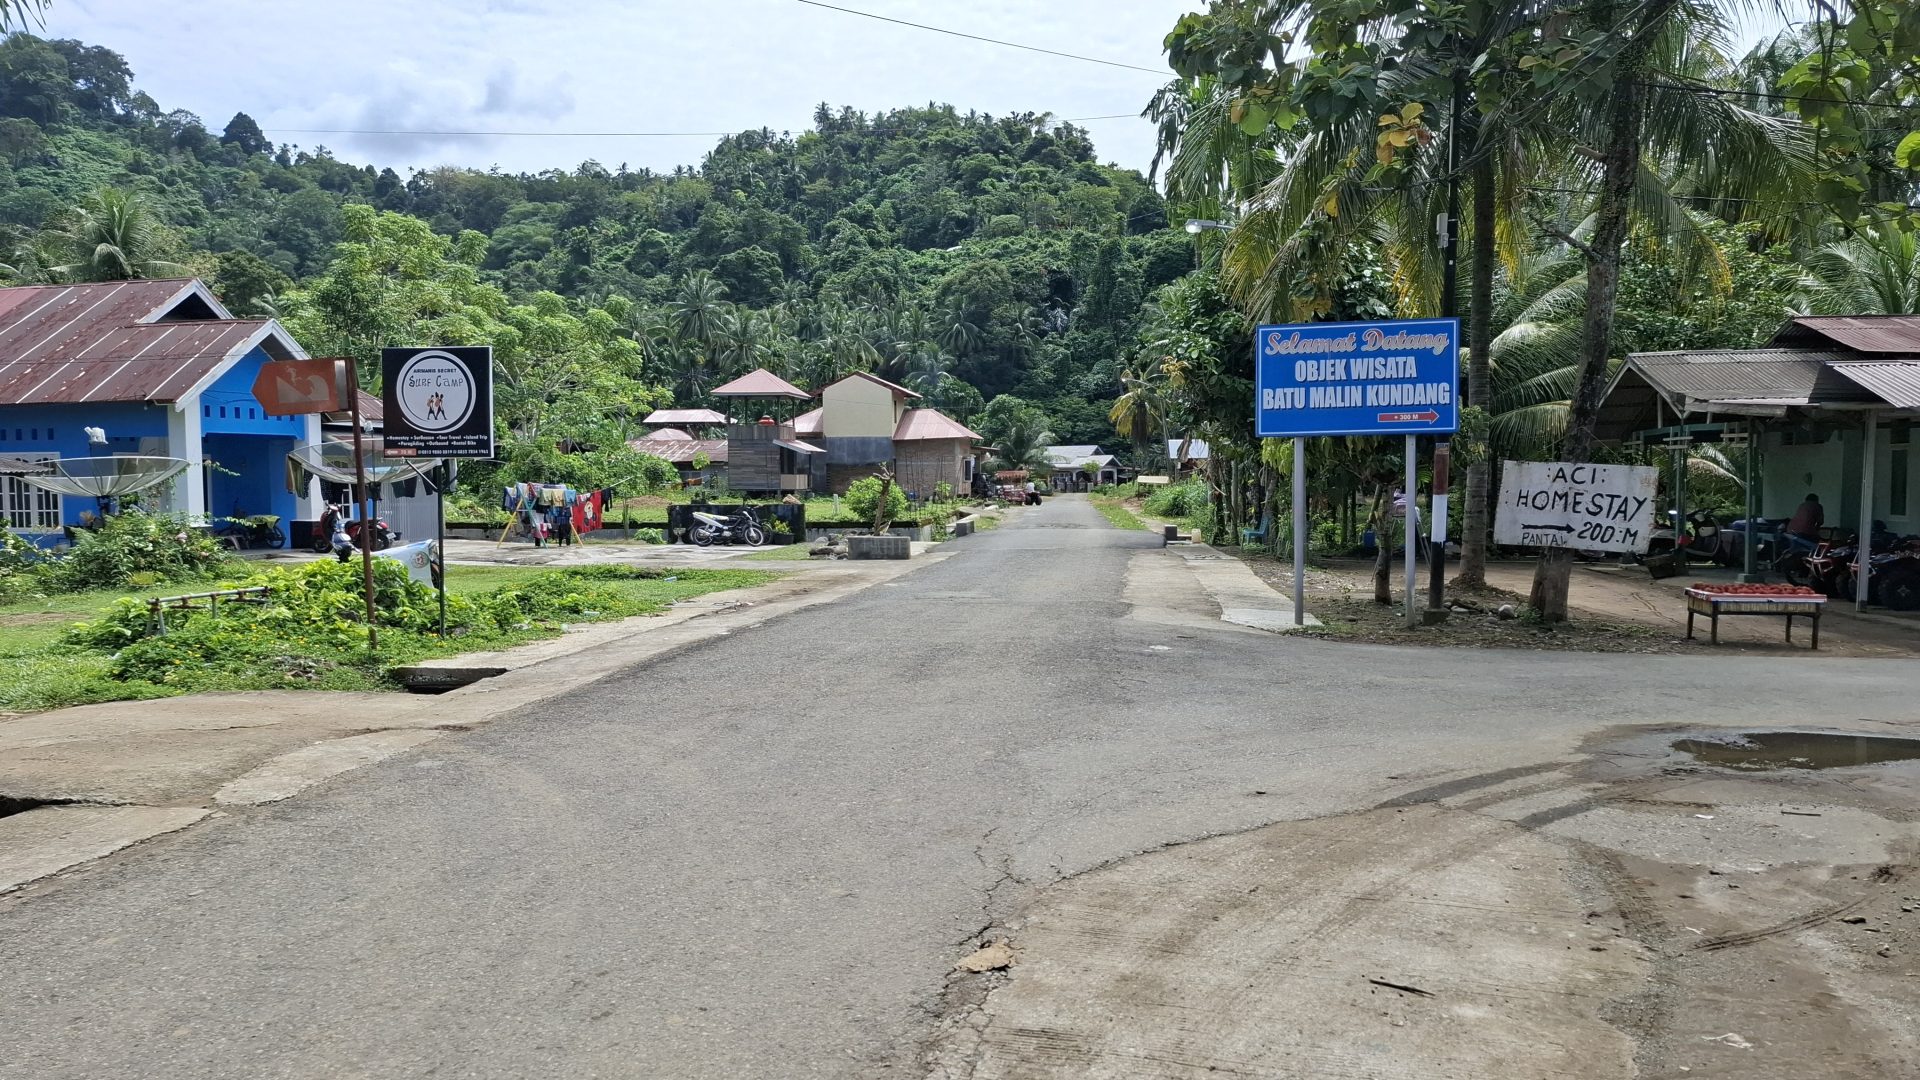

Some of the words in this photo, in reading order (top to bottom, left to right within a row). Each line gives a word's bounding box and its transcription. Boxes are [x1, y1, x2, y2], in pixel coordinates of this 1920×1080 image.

[1264, 331, 1357, 356] Selamat
[1360, 327, 1450, 356] Datang
[1294, 358, 1347, 382] OBJEK
[1349, 355, 1418, 380] WISATA
[1262, 387, 1306, 410] BATU
[1309, 385, 1363, 408] MALIN
[1366, 382, 1451, 406] KUNDANG
[1516, 489, 1648, 522] HOMESTAY
